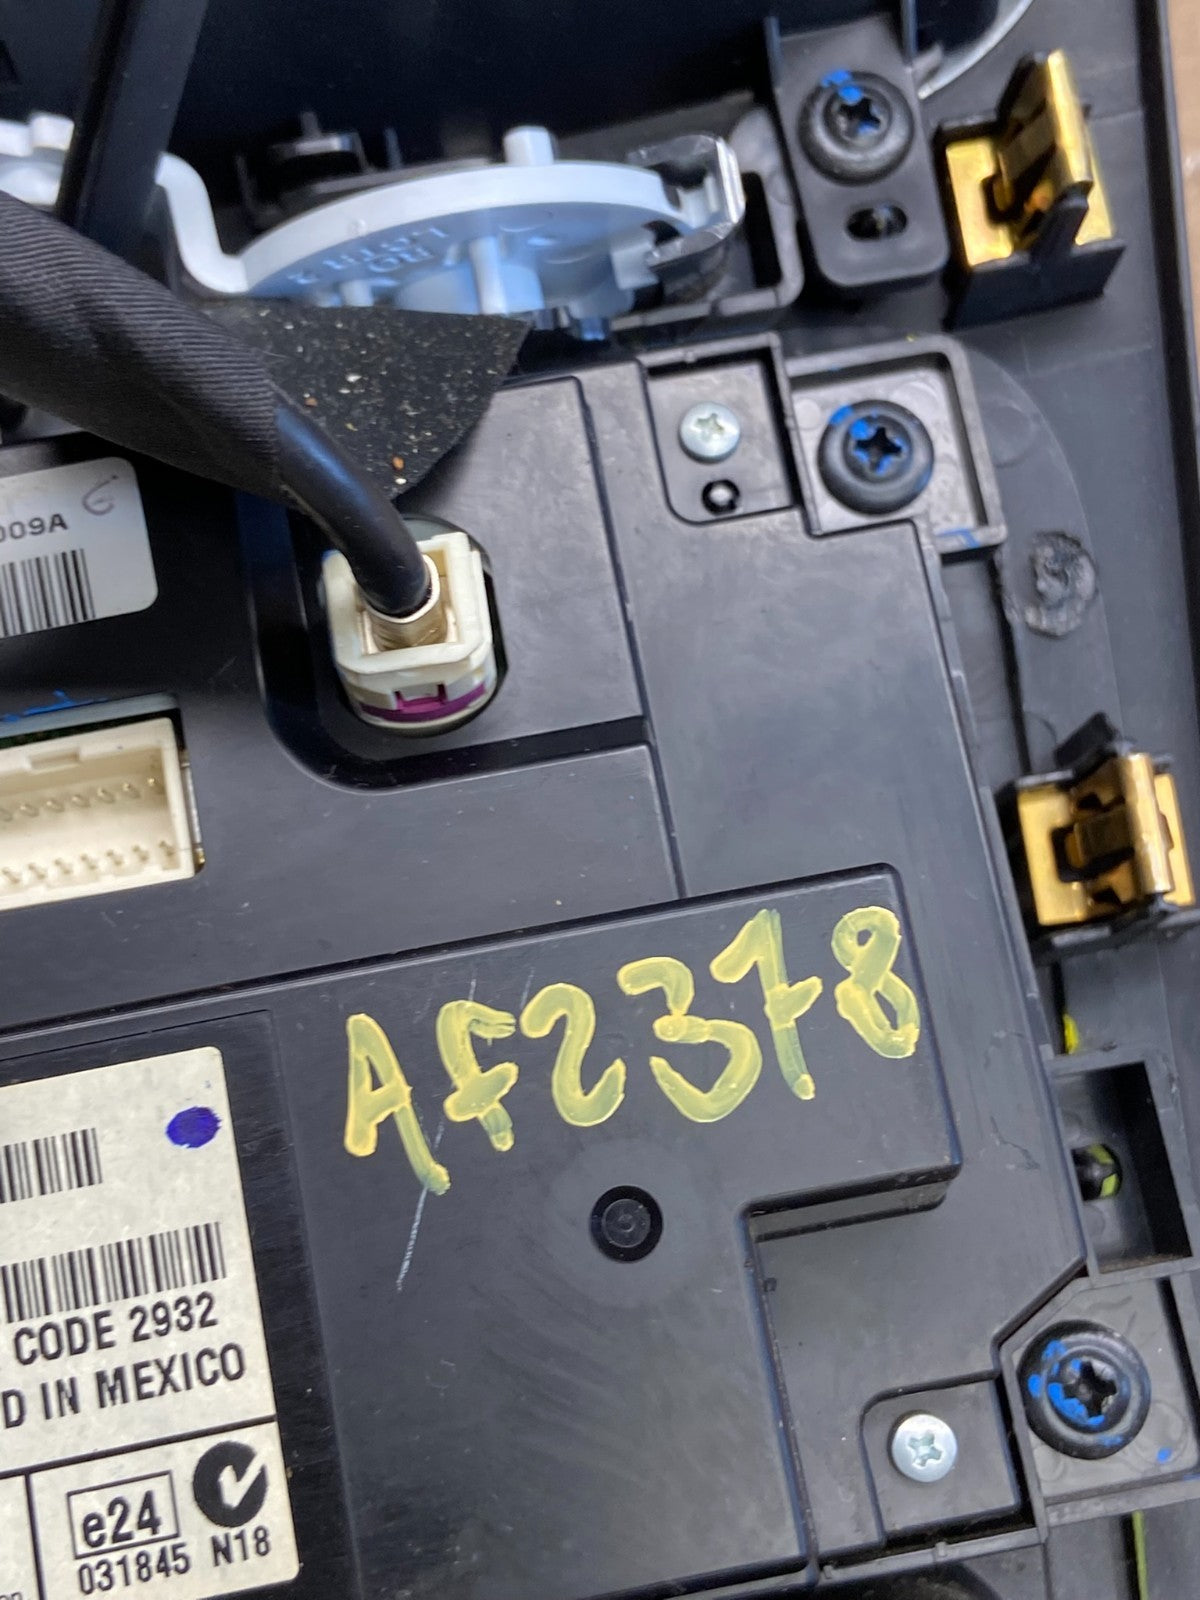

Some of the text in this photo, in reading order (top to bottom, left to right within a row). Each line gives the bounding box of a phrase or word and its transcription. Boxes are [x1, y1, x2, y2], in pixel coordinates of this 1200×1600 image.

[13, 1291, 219, 1365] CODE 2932
[40, 1377, 80, 1420] IN
[95, 1343, 245, 1409] MEXICO
[82, 1489, 162, 1548] e24
[211, 1525, 270, 1567] N18
[77, 1542, 191, 1595] 031845
